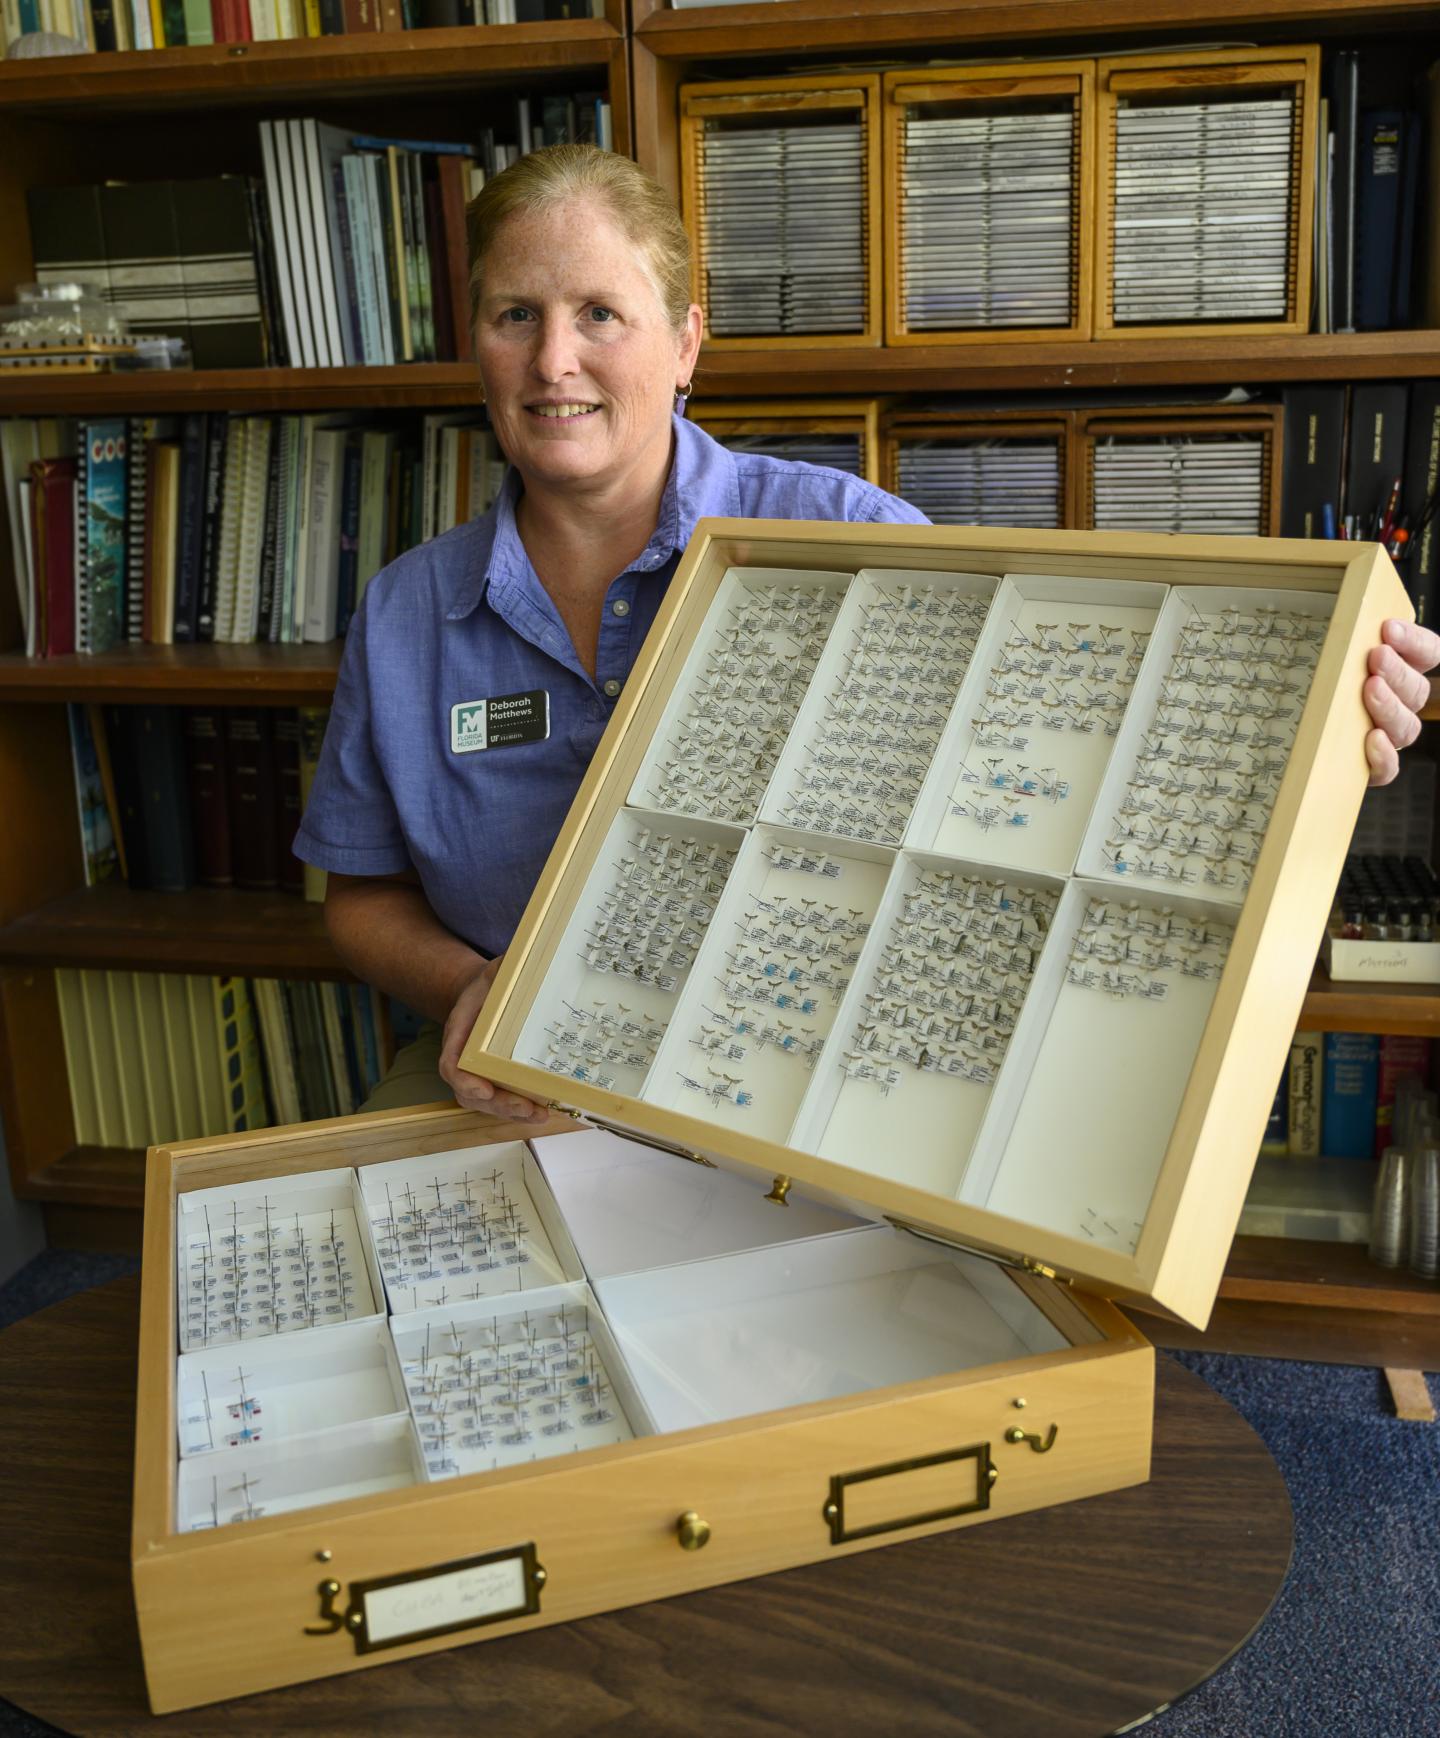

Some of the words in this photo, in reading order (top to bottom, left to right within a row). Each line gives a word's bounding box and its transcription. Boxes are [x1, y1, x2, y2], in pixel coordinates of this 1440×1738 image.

[490, 697, 531, 711] Deborah
[490, 708, 532, 721] Matthews
[457, 733, 482, 741] FLORIDA
[458, 739, 483, 748] MUSEUM
